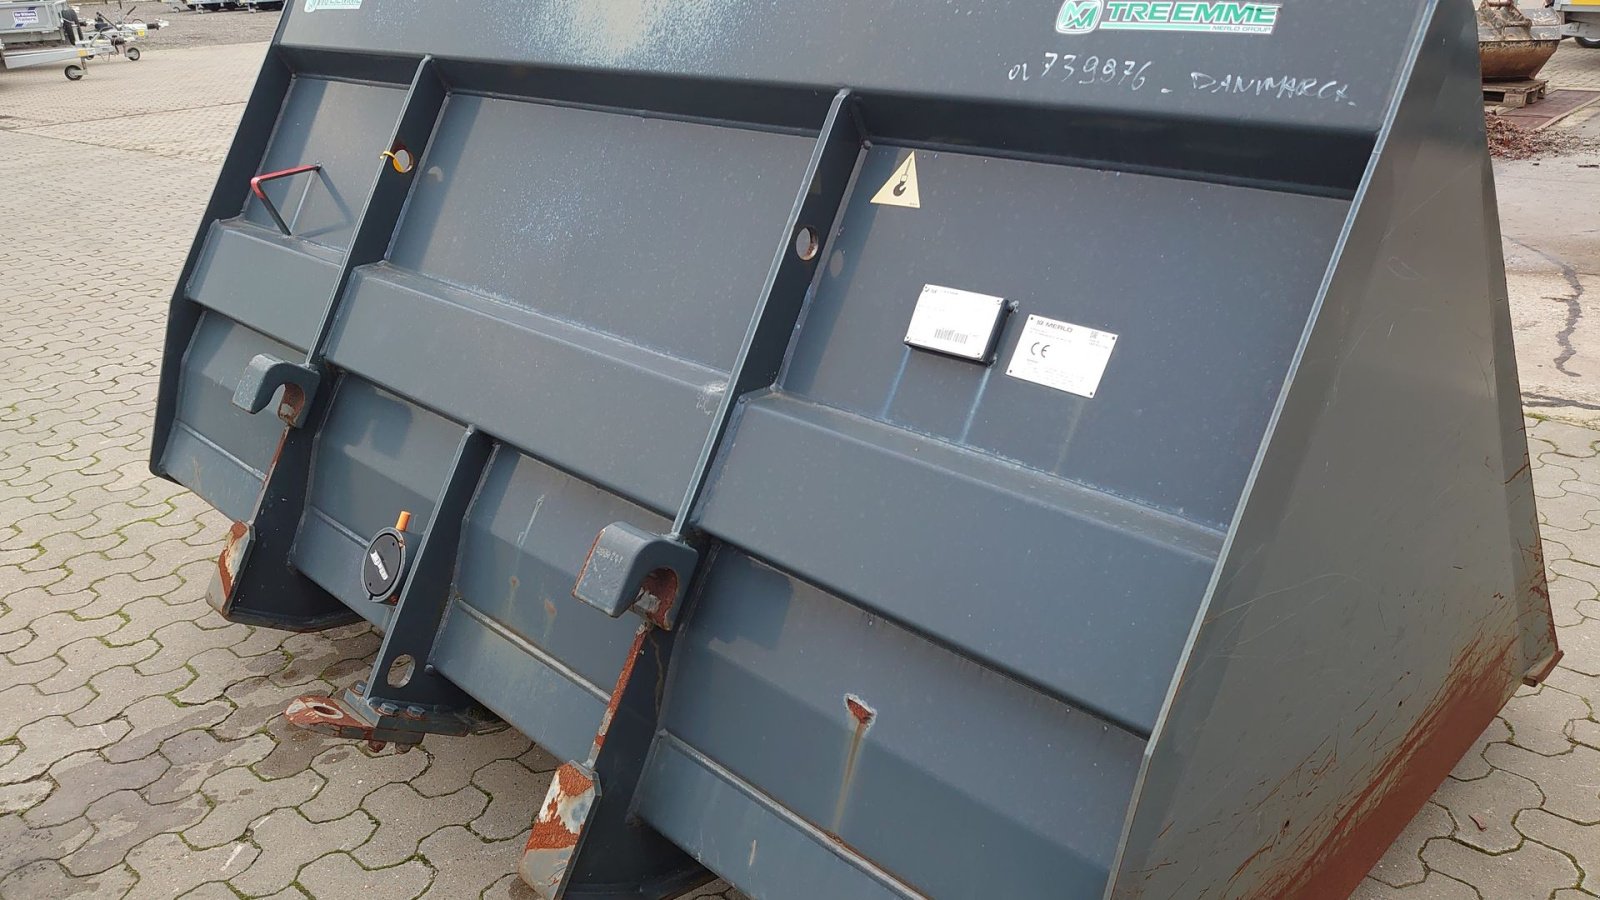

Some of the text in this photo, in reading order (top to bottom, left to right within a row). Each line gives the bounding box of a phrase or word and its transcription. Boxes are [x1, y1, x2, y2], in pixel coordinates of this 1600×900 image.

[1107, 2, 1278, 24] TREEMME
[1045, 322, 1073, 333] MERLO
[1030, 341, 1051, 359] CE
